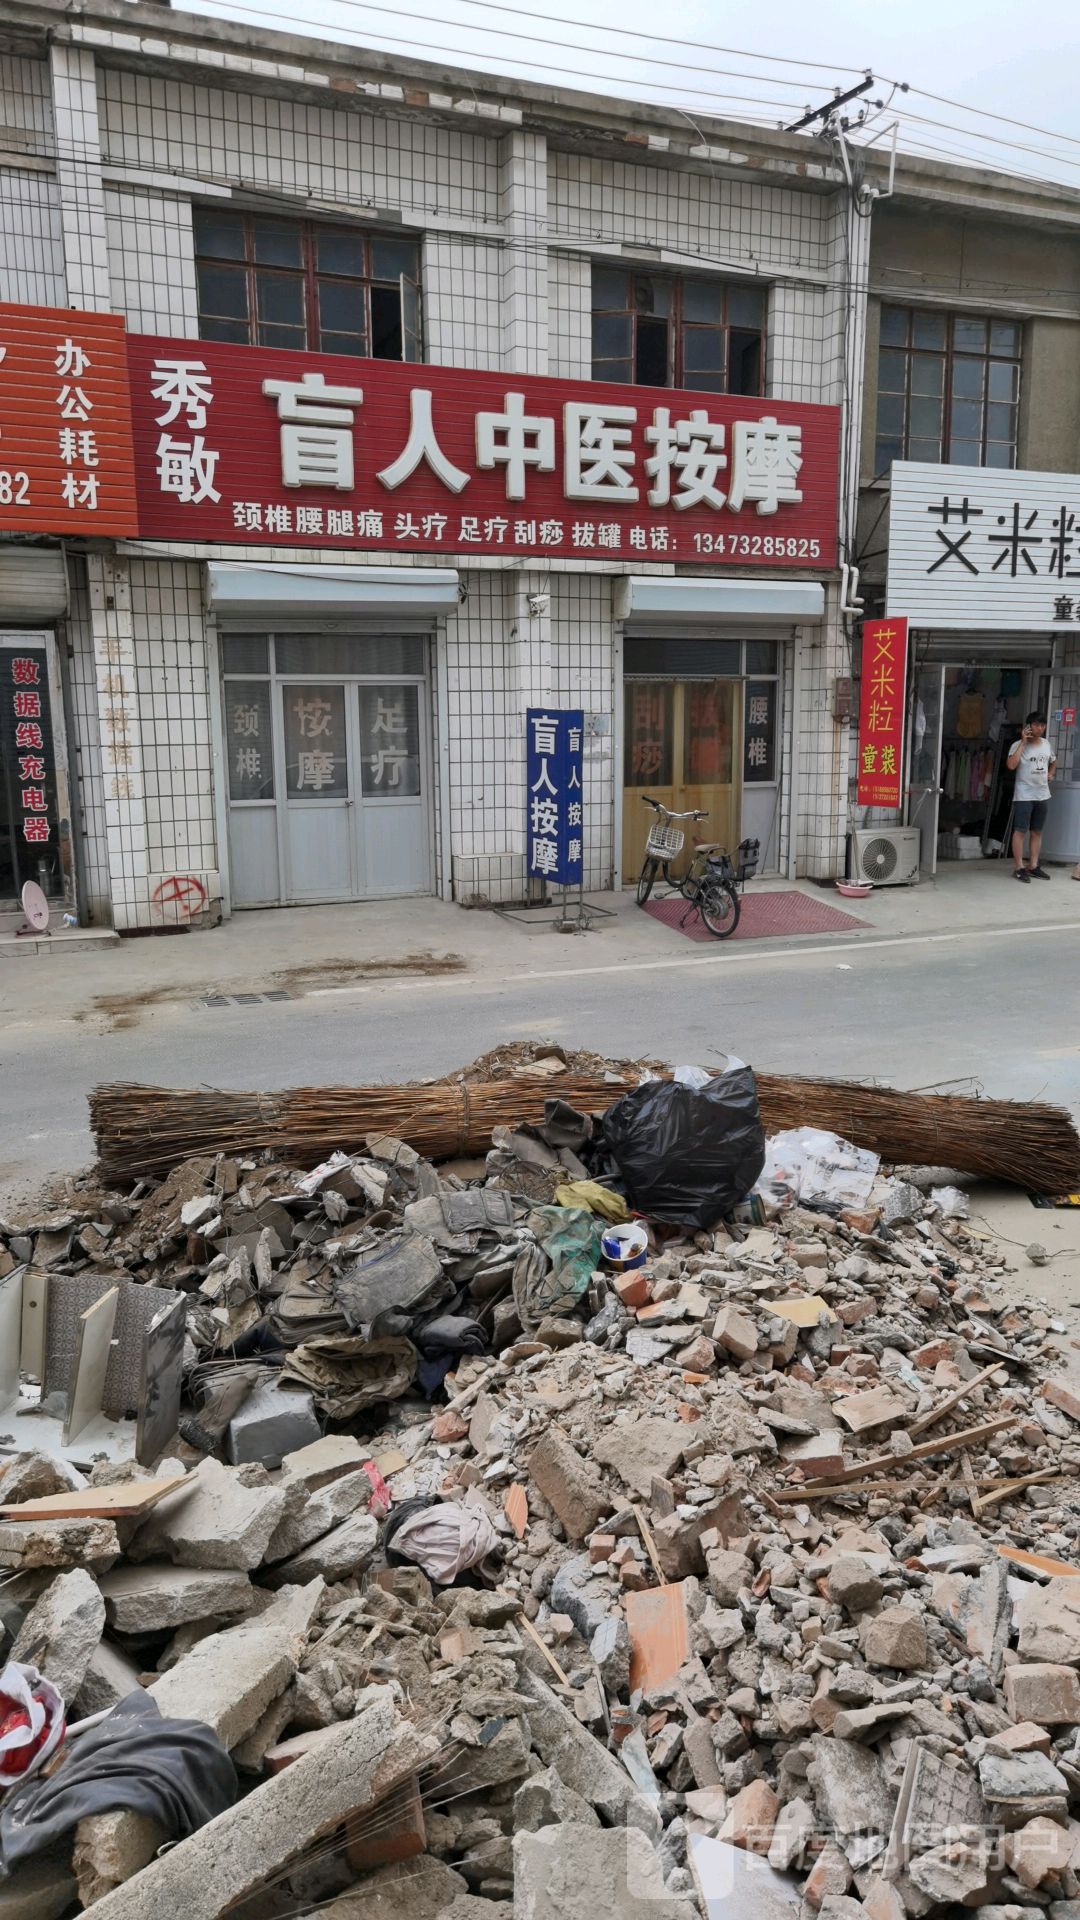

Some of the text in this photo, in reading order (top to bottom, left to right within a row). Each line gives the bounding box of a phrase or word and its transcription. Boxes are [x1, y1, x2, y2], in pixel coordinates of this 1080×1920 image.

[54, 338, 100, 510] 办公耗材
[150, 359, 222, 505] 秀敏
[262, 372, 803, 516] 盲人中医按摩
[232, 501, 384, 538] 颈椎腰腿痛
[394, 512, 448, 541] 头疗
[571, 521, 622, 549] 拔罐
[693, 532, 820, 559] 13473285825
[1053, 595, 1080, 621] 童
[868, 627, 897, 732] 艾米粒
[12, 657, 50, 842] 数据线充电器
[233, 704, 261, 779] 颈椎
[293, 698, 335, 790] 按摩
[370, 697, 408, 786] 足疗
[748, 696, 768, 766] 腰椎
[861, 743, 897, 775] 童装
[531, 715, 559, 875] 盲人按摩
[568, 727, 582, 863] 盲人按摩
